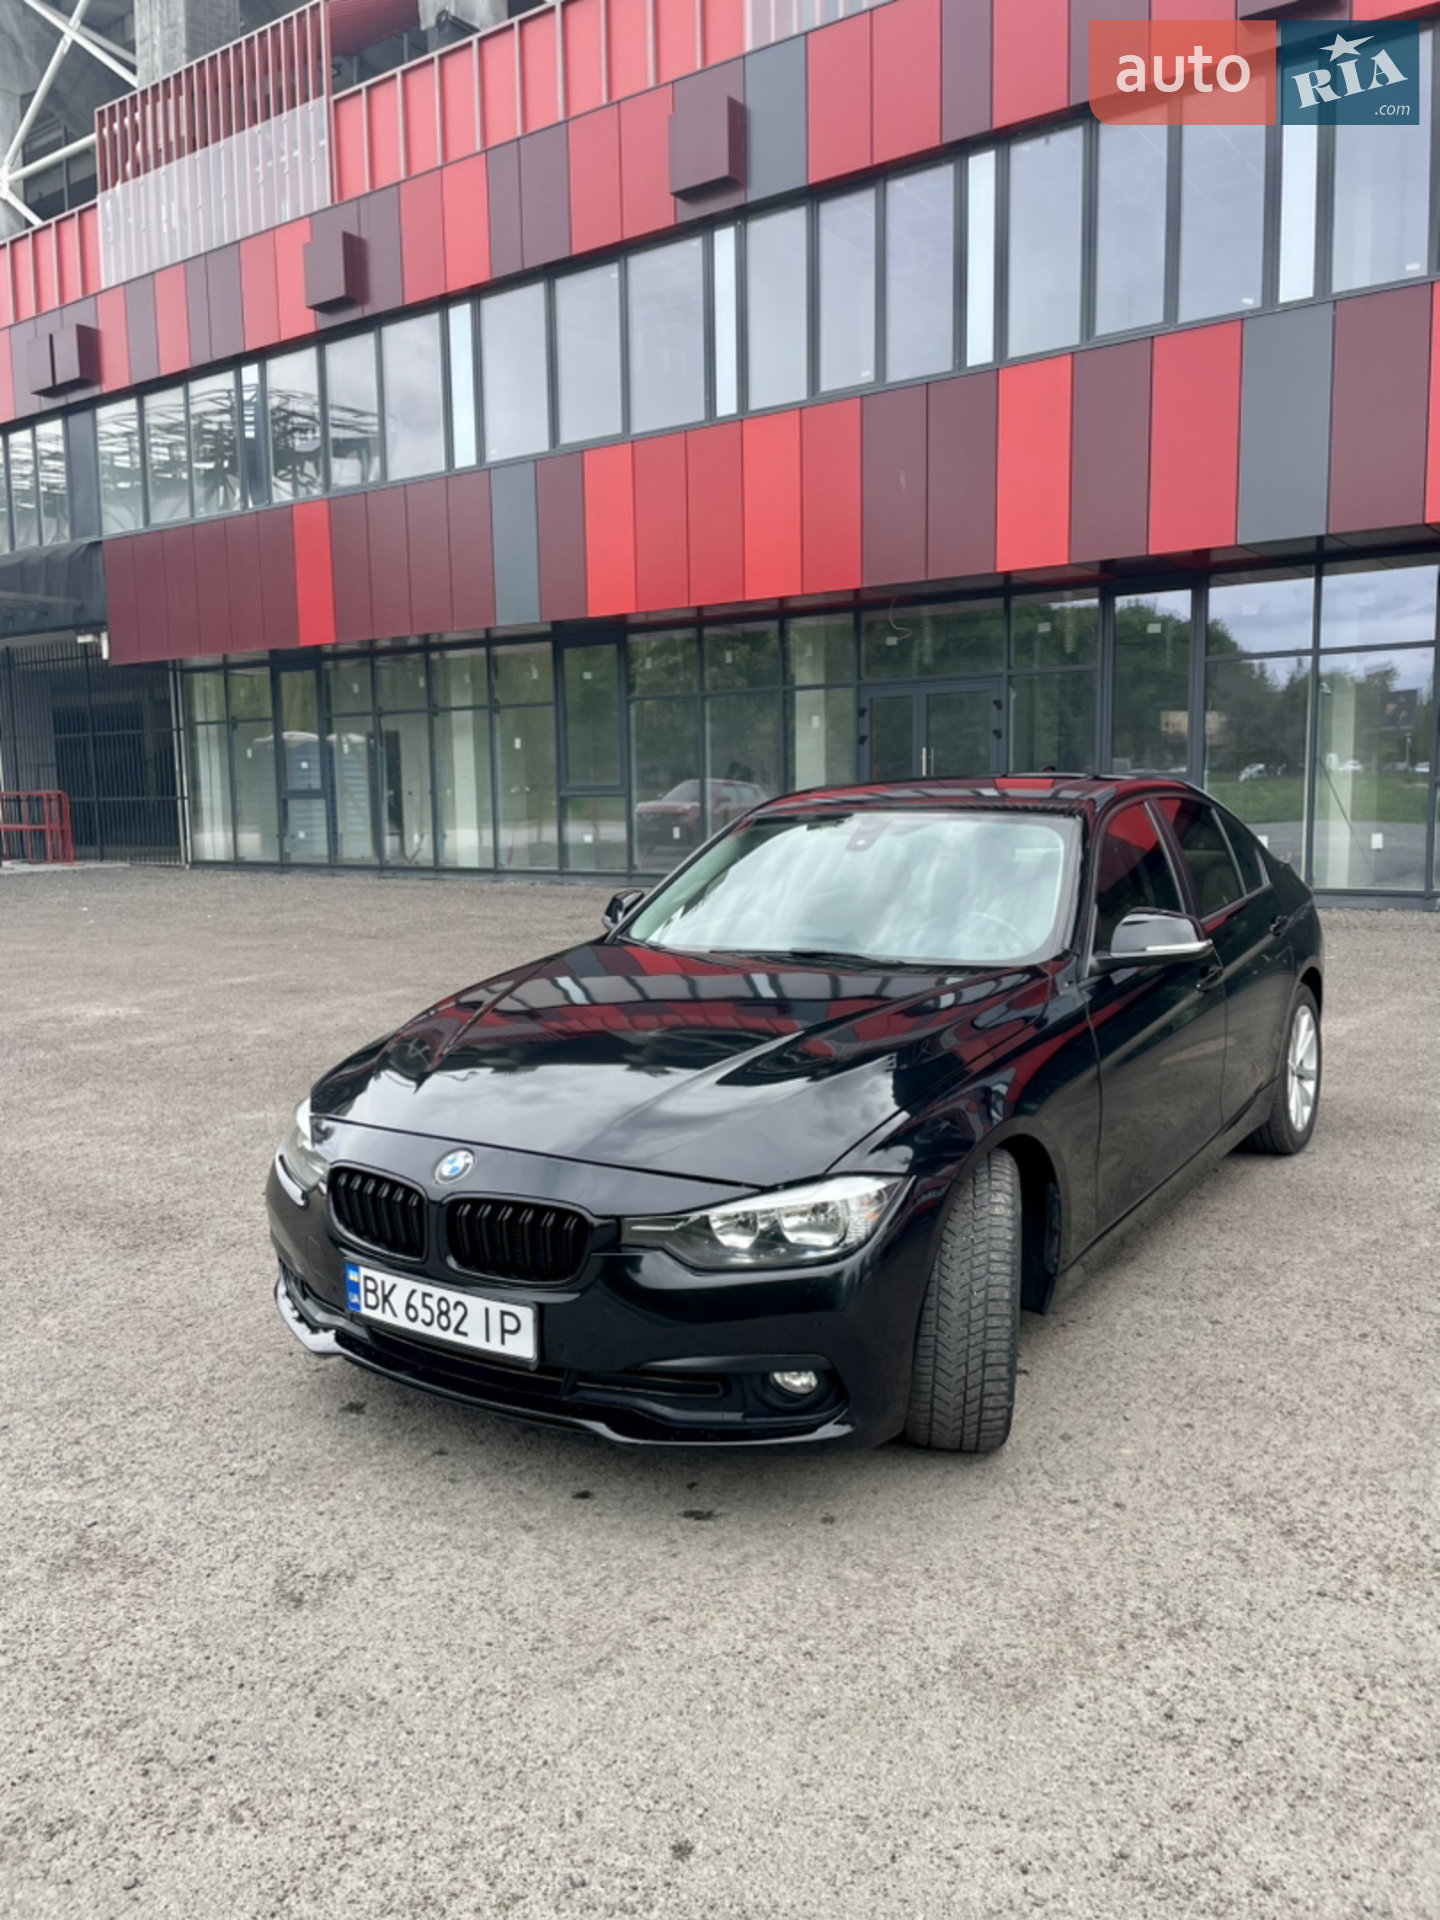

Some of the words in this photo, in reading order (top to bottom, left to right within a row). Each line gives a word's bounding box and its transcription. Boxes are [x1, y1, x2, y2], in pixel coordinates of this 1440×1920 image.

[363, 1275, 398, 1318] BK
[405, 1289, 469, 1338] 6582
[485, 1306, 522, 1346] IP
